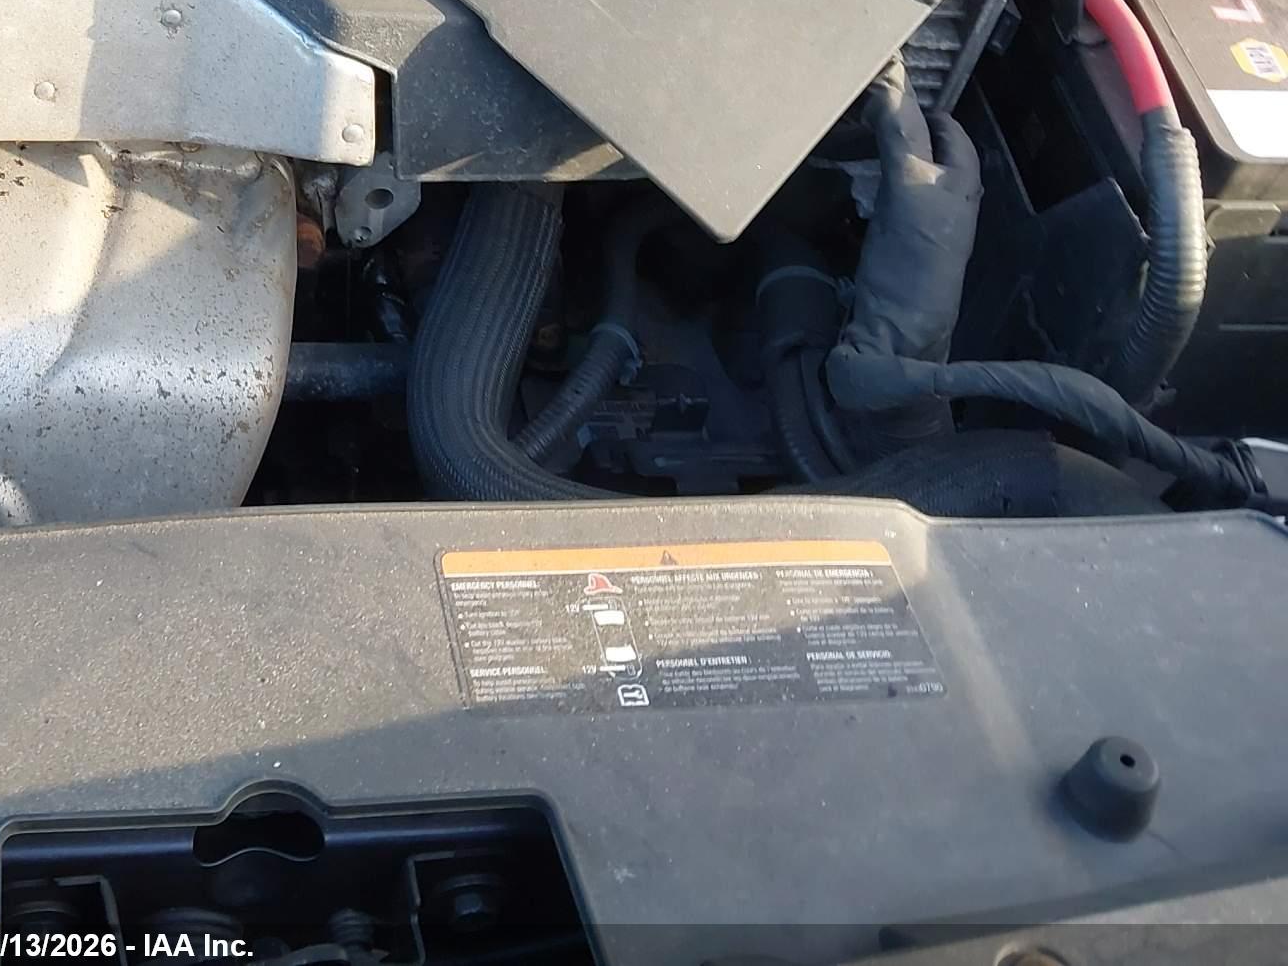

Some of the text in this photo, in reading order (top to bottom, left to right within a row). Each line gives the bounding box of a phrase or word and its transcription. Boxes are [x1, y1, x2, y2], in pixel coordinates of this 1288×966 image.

[566, 604, 580, 613] 12V
[470, 668, 501, 678] SERVICE
[582, 666, 597, 674] 12V
